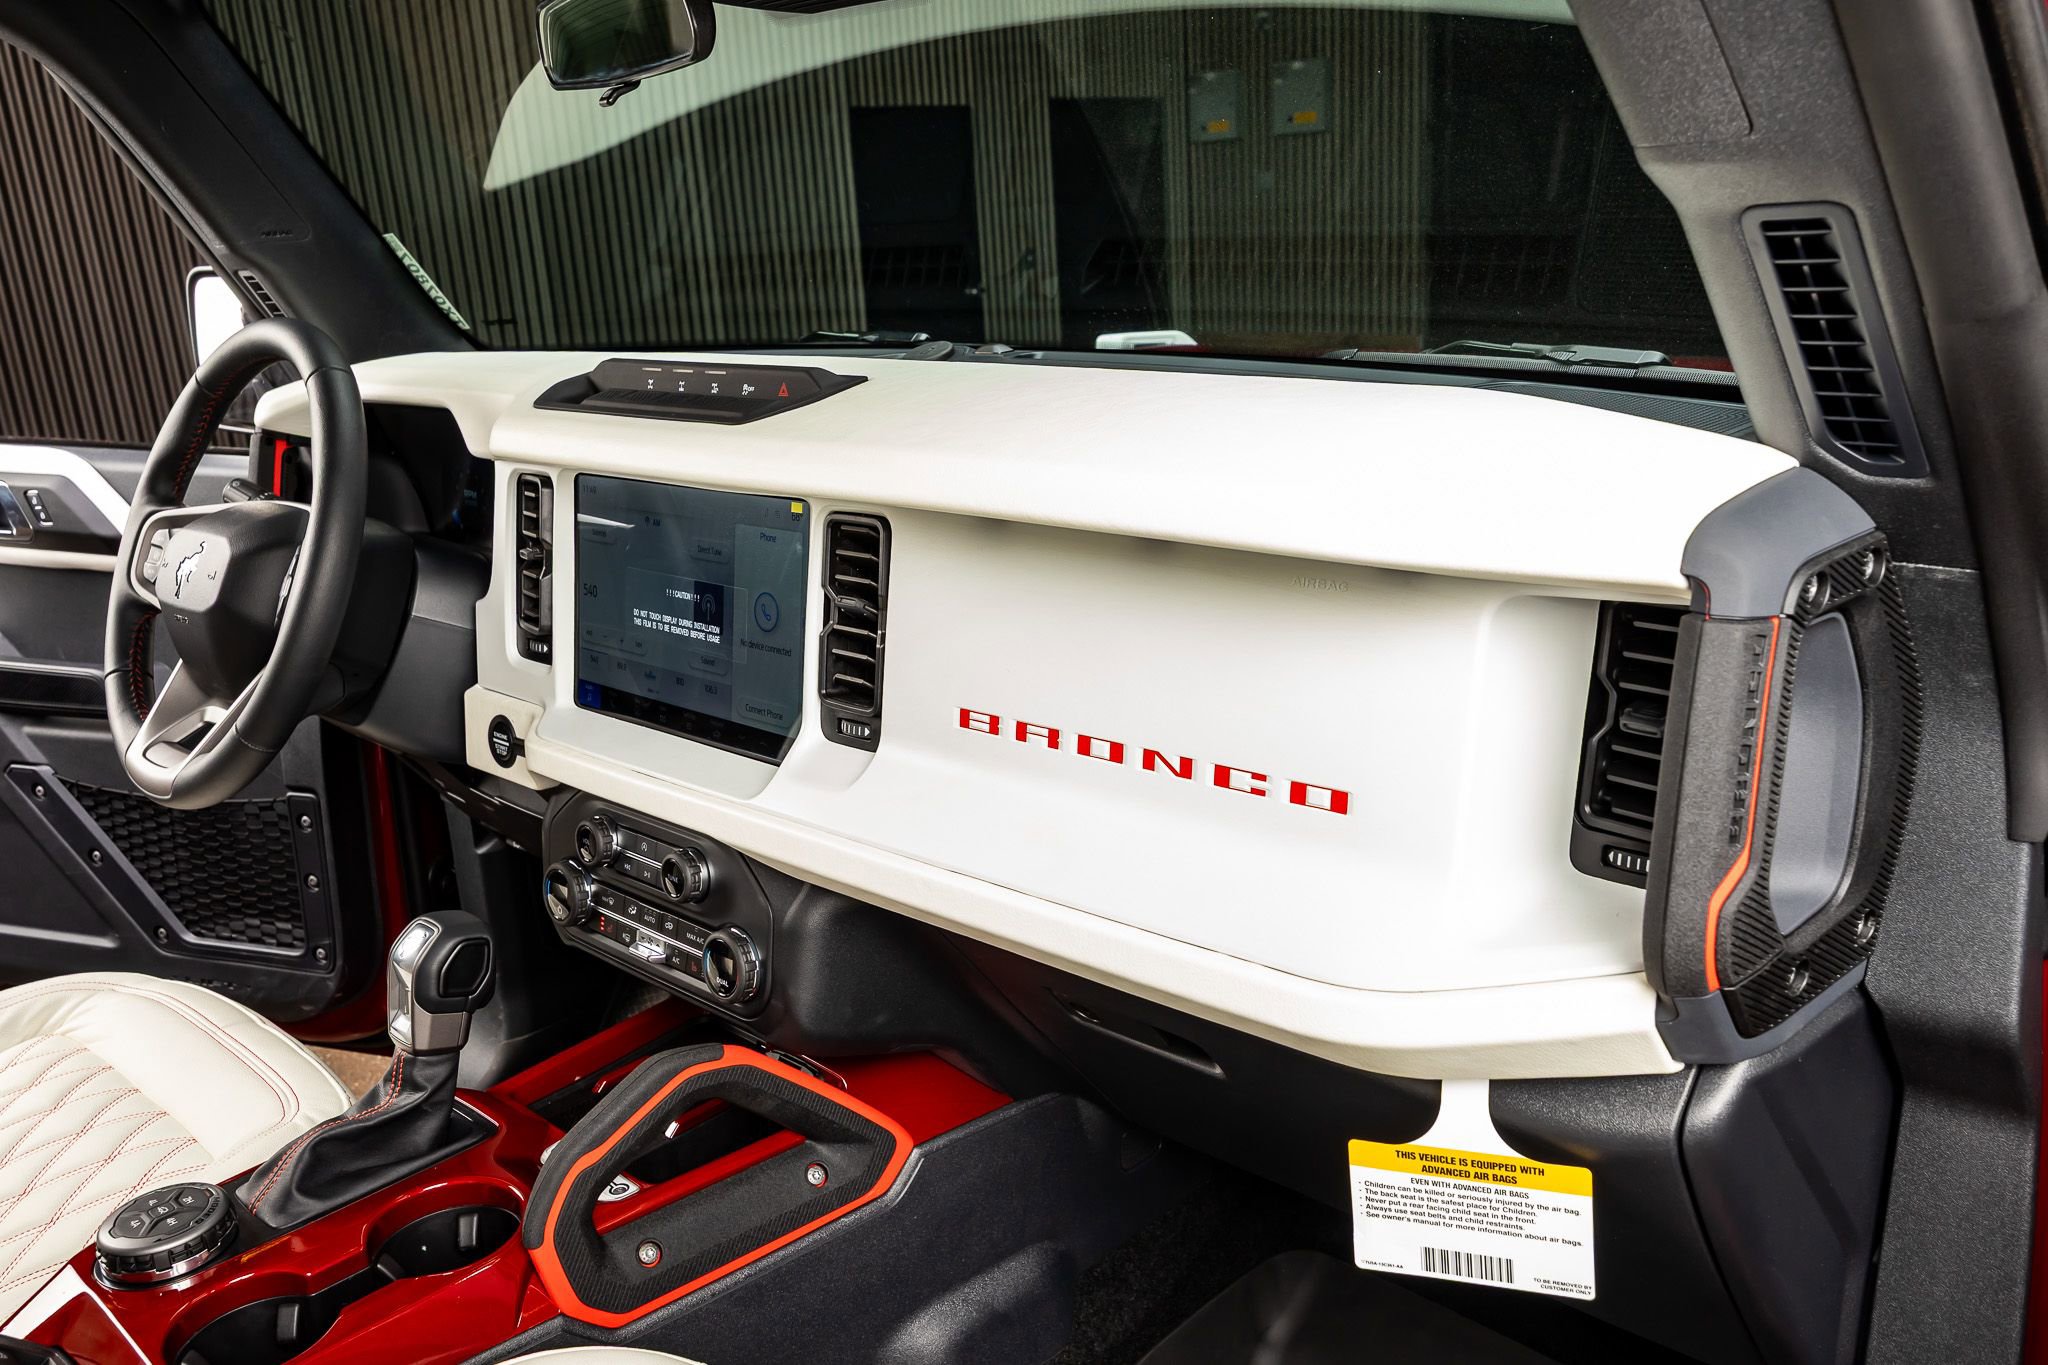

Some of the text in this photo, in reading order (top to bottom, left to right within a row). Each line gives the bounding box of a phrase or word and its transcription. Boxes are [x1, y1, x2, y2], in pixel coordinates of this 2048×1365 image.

[760, 532, 777, 543] Phone
[583, 583, 598, 599] 540
[1289, 575, 1350, 593] AIRBAG
[642, 619, 651, 627] FILM
[657, 622, 663, 630] TO
[670, 625, 689, 636] REMOVED
[690, 630, 705, 640] BEFORE
[706, 634, 720, 643] USAGE
[649, 612, 661, 621] TOUCH
[662, 614, 677, 624] DISPLAY
[678, 618, 692, 628] DURING
[693, 621, 720, 634] INSTALLATION
[740, 638, 792, 657] No device connected
[745, 703, 783, 721] Connect Phone
[957, 706, 1351, 816] BRONCO
[644, 914, 656, 924] AUTO
[686, 932, 705, 945] MAX A/C
[672, 956, 680, 965] A/C
[716, 976, 729, 988] DUAL
[1395, 1149, 1544, 1176] THIS VEHICLE IS EQUIPPED WITH
[1421, 1164, 1517, 1185] ADVANCED AIR BAGS
[1364, 1180, 1395, 1191] Children
[1424, 1188, 1445, 1197] killed
[1457, 1192, 1492, 1204] seriously
[1495, 1198, 1523, 1208] injured
[1524, 1202, 1534, 1210] by
[1536, 1203, 1549, 1211] the
[1410, 1177, 1529, 1199] EVEN WITH ADVANCED AIR BAGS
[1364, 1187, 1378, 1196] The
[1380, 1190, 1397, 1198] back
[1440, 1197, 1464, 1207] safest
[1466, 1201, 1487, 1211] place
[1489, 1204, 1500, 1212] for
[1364, 1195, 1386, 1204] Never
[1388, 1199, 1401, 1207] put
[1426, 1203, 1450, 1214] facing
[1451, 1207, 1471, 1215] child
[1472, 1210, 1489, 1218] seat
[1500, 1213, 1513, 1221] the
[1365, 1202, 1392, 1213] Always
[1409, 1209, 1425, 1217] seat
[1427, 1211, 1446, 1219] belts
[1448, 1214, 1463, 1222] and
[1464, 1216, 1484, 1225] child
[1365, 1210, 1380, 1218] See
[1381, 1213, 1411, 1222] owner's
[1412, 1217, 1441, 1226] manual
[1455, 1223, 1475, 1231] more
[1477, 1226, 1522, 1238] information
[1524, 1232, 1547, 1241] about
[1540, 1283, 1574, 1292] CUSTOMER
[1552, 1280, 1583, 1289] REMOVED
